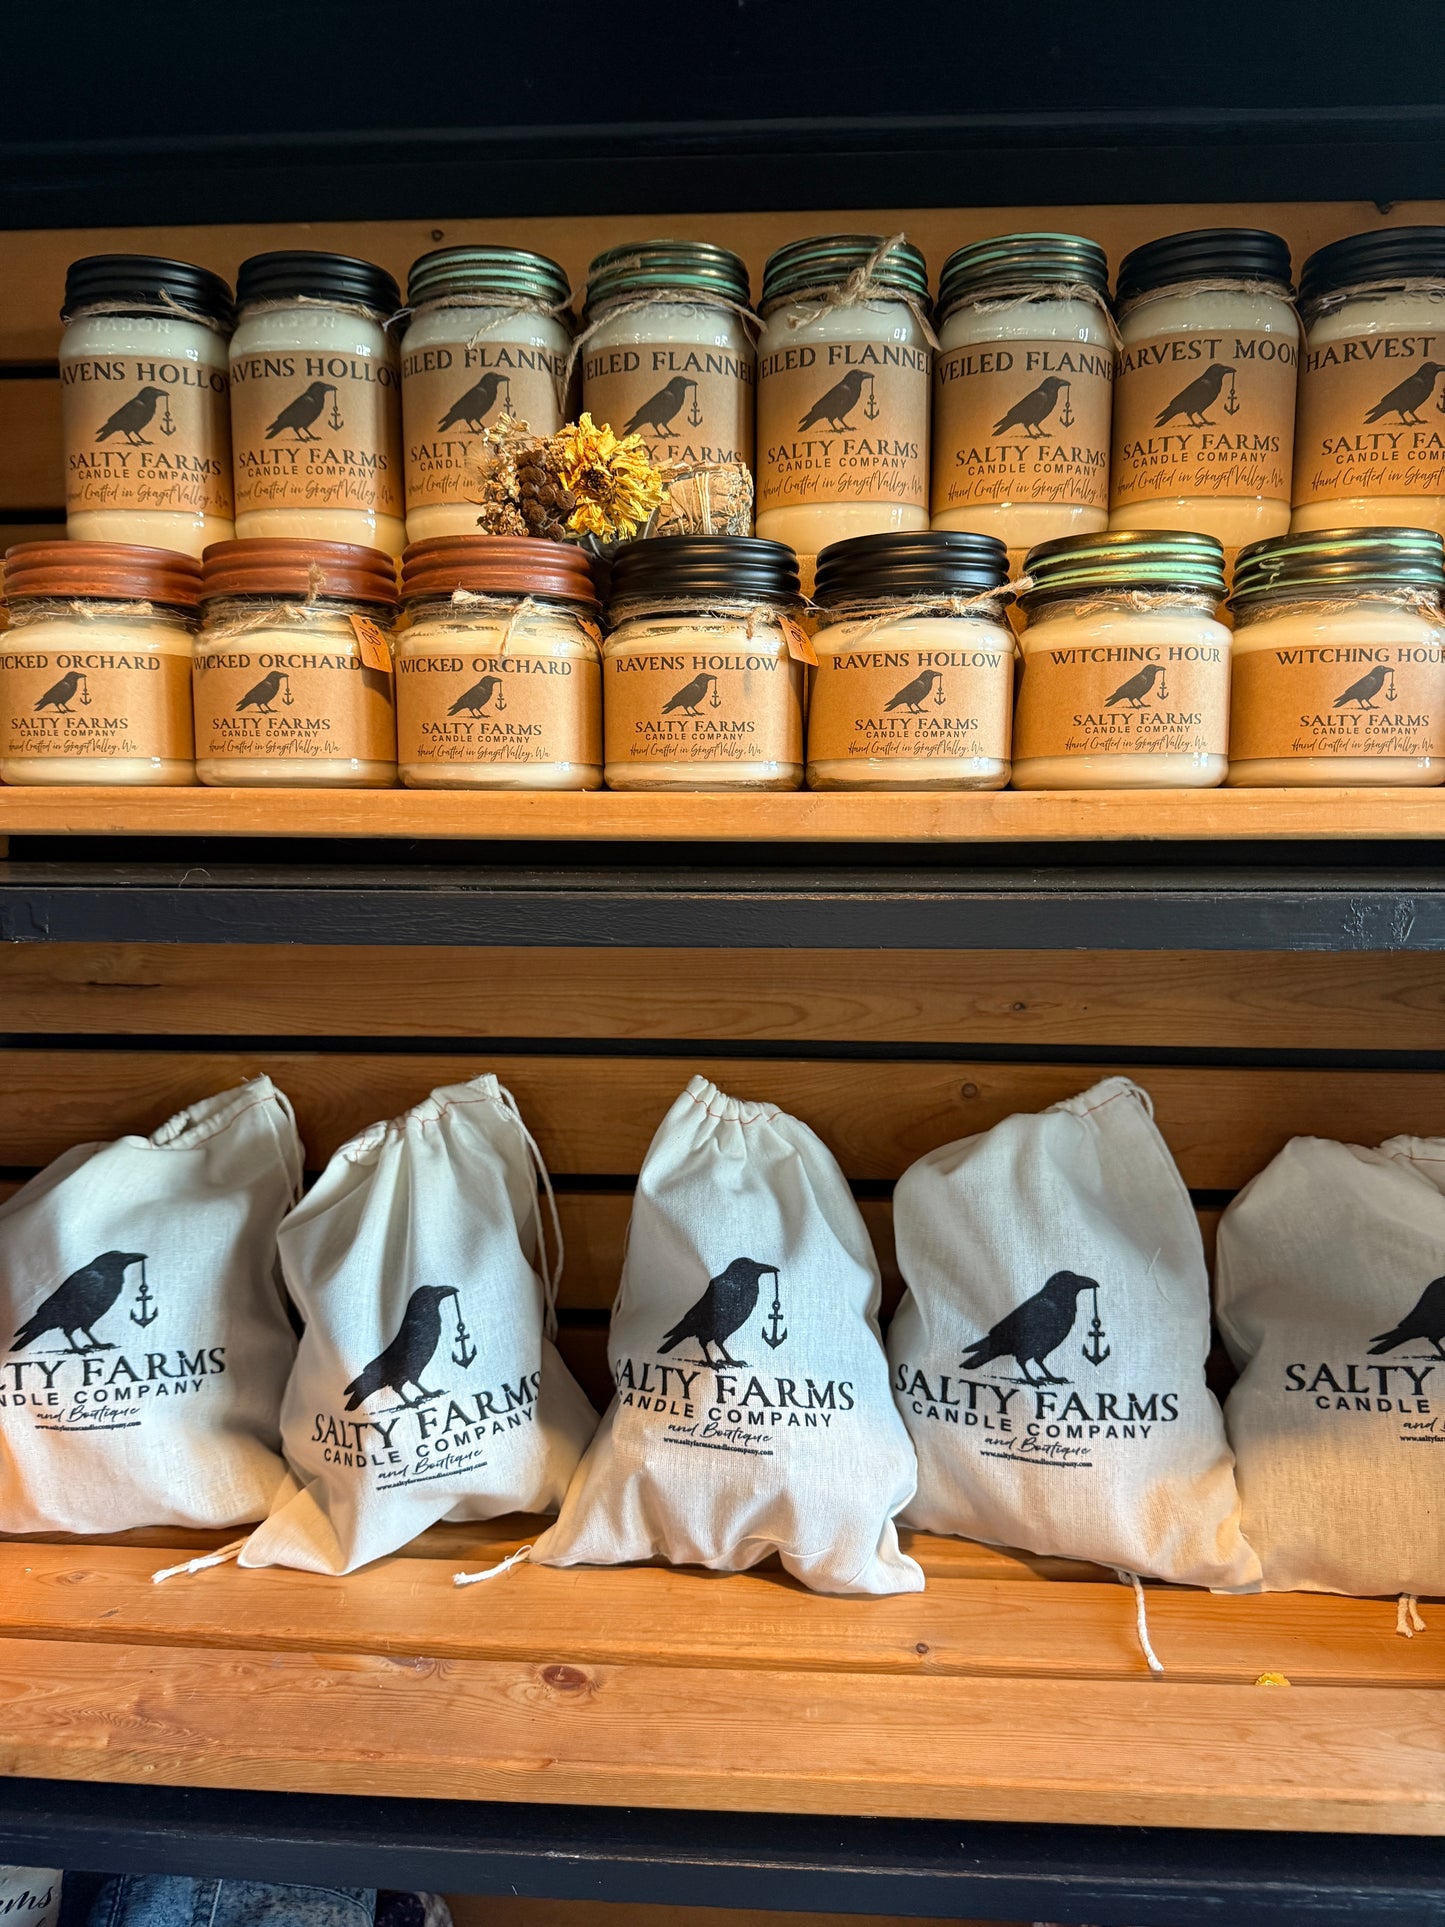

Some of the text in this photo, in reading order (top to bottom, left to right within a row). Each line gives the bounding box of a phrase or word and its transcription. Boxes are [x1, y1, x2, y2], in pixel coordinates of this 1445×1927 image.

[464, 348, 567, 377] FLANNE
[828, 344, 931, 376] FLANNEL
[1114, 339, 1222, 380] HARVEST
[1306, 337, 1436, 373] HARVEST
[60, 361, 126, 387] AVENS
[584, 351, 640, 382] EILED
[939, 352, 1014, 385] VEILED
[411, 441, 472, 463] SALTY
[768, 439, 918, 464] SALTY FARMS
[1123, 433, 1280, 461] SALTY FARMS
[1321, 432, 1405, 455] SALTY
[239, 448, 388, 469] SALTY FARMS
[668, 445, 742, 463] FARMS
[956, 446, 1106, 467] SALTY FARMS
[1133, 452, 1267, 469] CANDLE COMPANY
[1336, 451, 1399, 464] CANDLE
[69, 452, 222, 475] SALTY FARMS
[248, 466, 375, 478] CANDLE COMPANY
[778, 457, 907, 473] CANDLE COMPANY
[968, 463, 1097, 477] CANDLE COMPANY
[78, 469, 208, 483] CANDLE COMPANY
[1311, 467, 1402, 491] Hand Crafted in
[0, 655, 160, 670] ICKED ORCHARD
[193, 654, 361, 670] WICKED ORCHARD
[616, 656, 779, 673] RAVENS HOLLOW
[833, 652, 1001, 670] RAVENS HOLLOW
[1050, 647, 1221, 665] WITCHING HOUR
[1276, 648, 1390, 665] WITCHING
[400, 658, 572, 675] WICKED ORCHARD
[11, 717, 129, 729] SALTY FARMS
[212, 718, 331, 730] SALTY FARMS
[635, 720, 755, 733] SALTY FARMS
[854, 718, 978, 731] SALTY FARMS
[1073, 712, 1202, 727] SALTY FARMS
[1300, 715, 1430, 727] SALTY FARMS
[20, 729, 116, 737] CANDLE COMPANY
[422, 722, 542, 736] SALTY FARMS
[866, 731, 909, 739] CANDLE
[1085, 725, 1191, 734] CANDLE COMPANY
[1313, 727, 1418, 735] CANDLE COMPANY
[478, 735, 530, 743] COMPANY
[82, 1347, 226, 1387] FARMS
[1285, 1362, 1435, 1396] SALTY
[74, 1378, 204, 1404] COMPANY
[715, 1374, 855, 1411] FARMS
[895, 1363, 1179, 1422] SALTY FARMS
[620, 1390, 833, 1428] ANDLE COMPANY
[1316, 1395, 1430, 1414] CANDLE
[36, 1405, 141, 1423] and Boutique
[912, 1400, 1153, 1439] CANDLE COMPANY
[311, 1413, 401, 1452] SALTY
[667, 1421, 774, 1443] and Boutique
[1403, 1417, 1438, 1433] and
[324, 1406, 534, 1468] CANDLE COMPANY
[984, 1435, 1093, 1458] and Boutique
[377, 1448, 485, 1480] and Boutique
